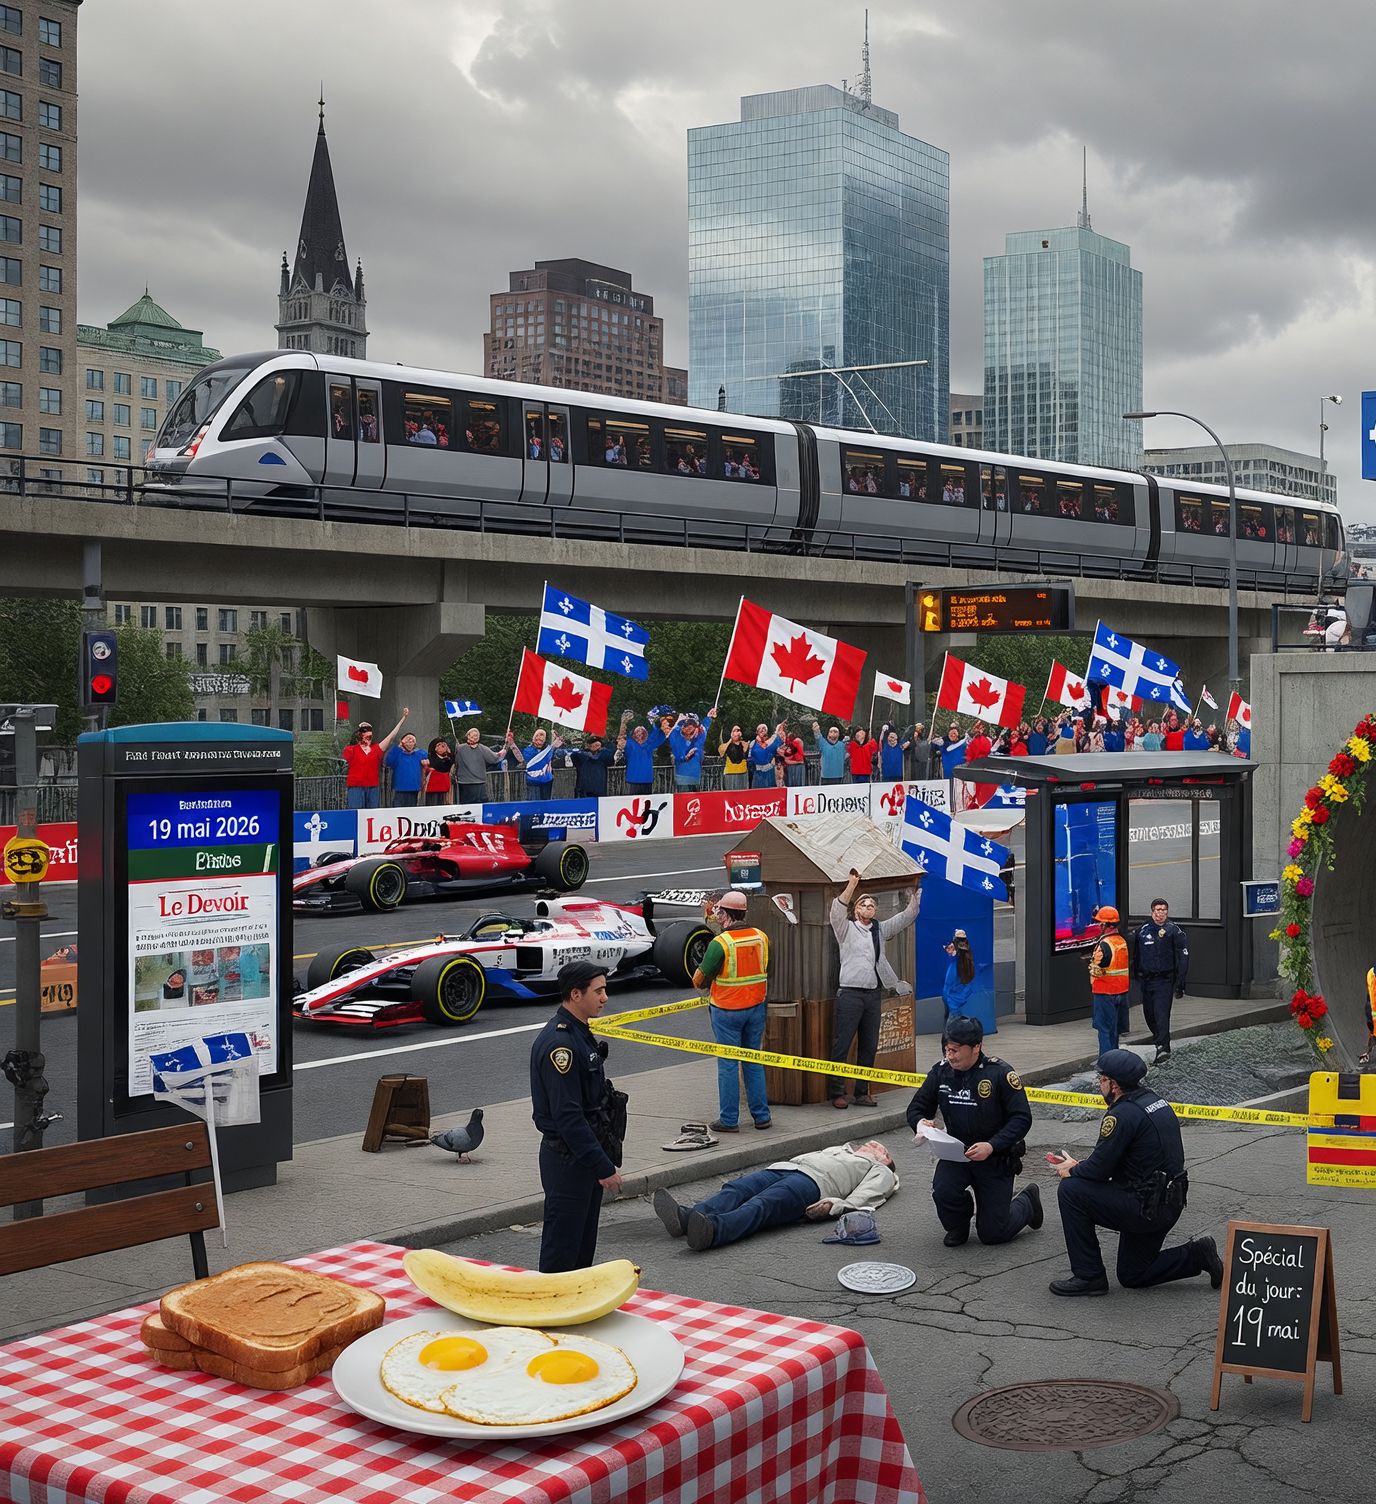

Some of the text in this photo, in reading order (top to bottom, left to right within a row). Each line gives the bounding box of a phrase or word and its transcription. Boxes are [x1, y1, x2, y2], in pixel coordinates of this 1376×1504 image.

[149, 815, 260, 840] 19 mai 2026
[158, 891, 249, 917] Le Devoir
[1239, 1238, 1305, 1272] Spécial
[1235, 1271, 1303, 1304] du jour:
[1231, 1304, 1300, 1348] 19 mai
